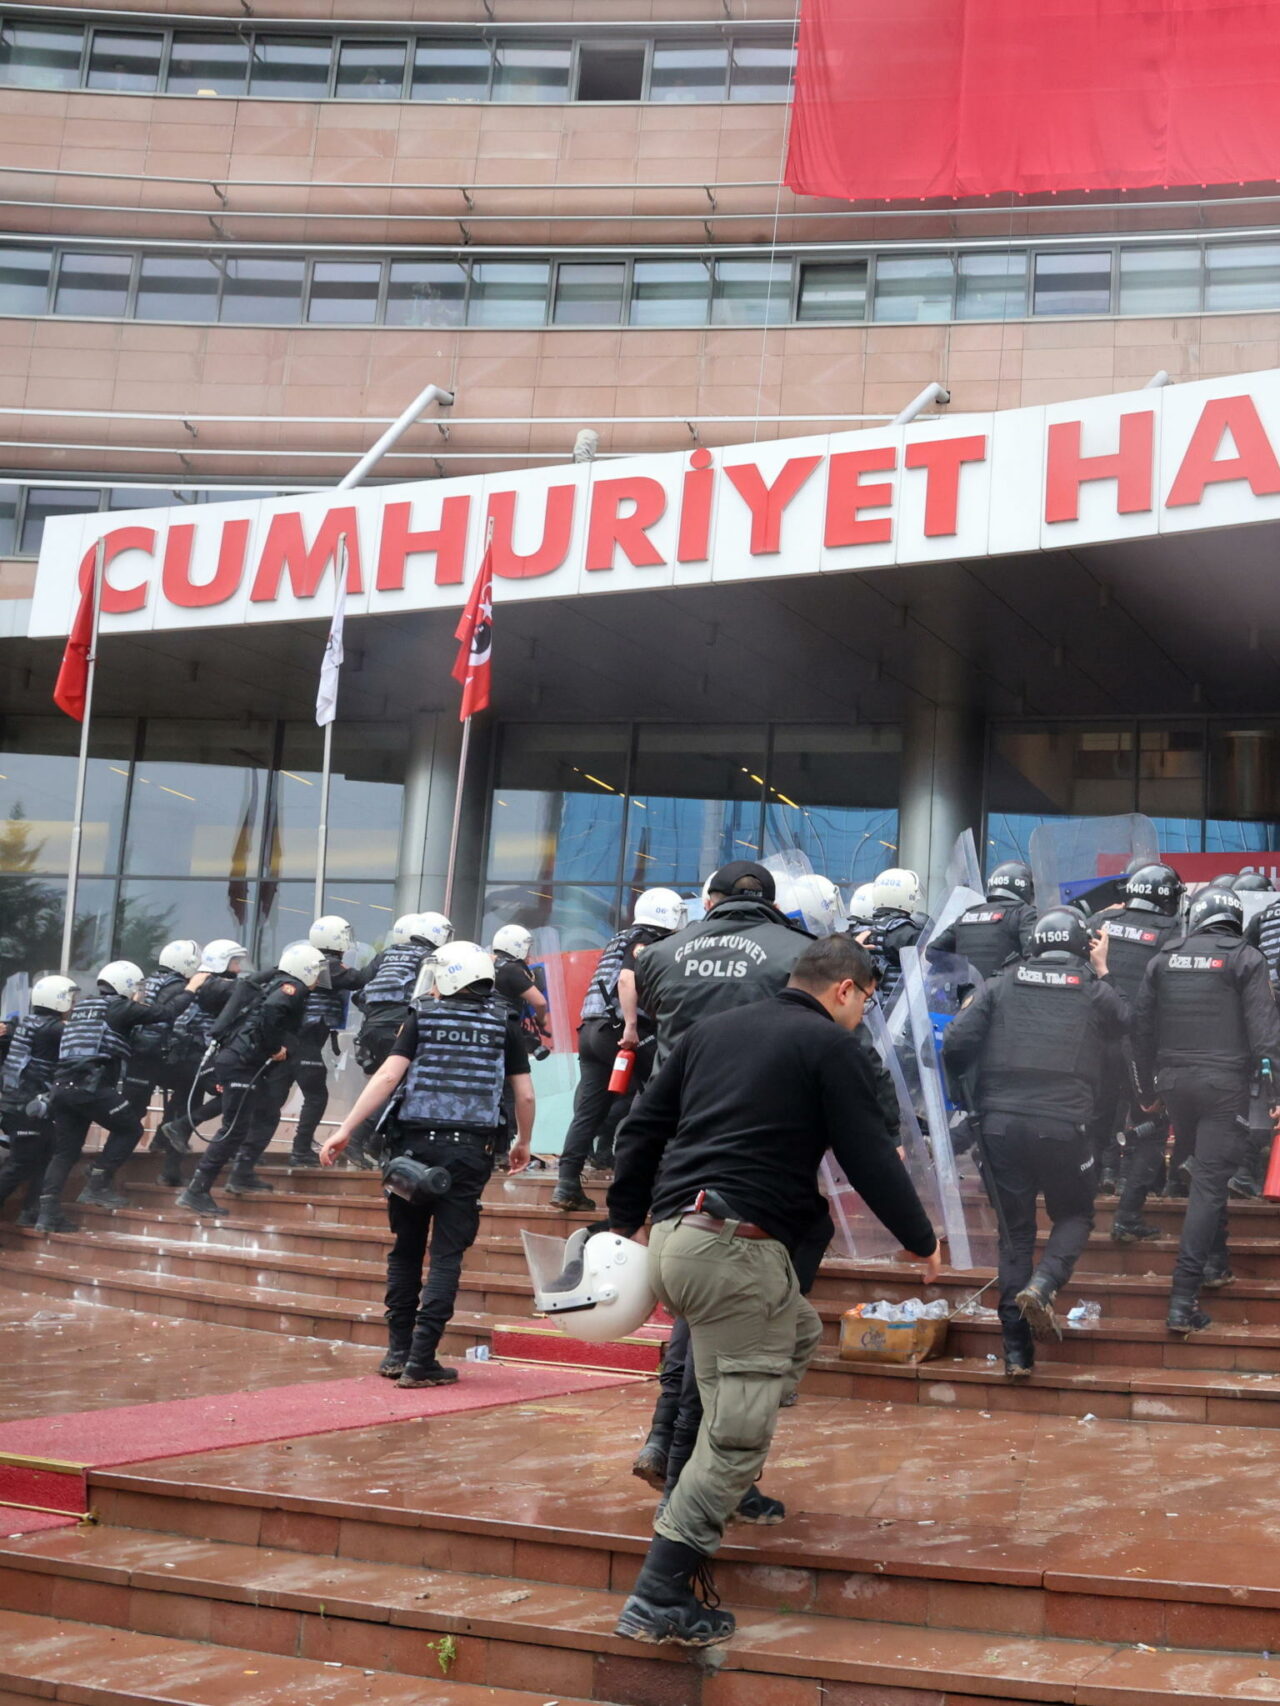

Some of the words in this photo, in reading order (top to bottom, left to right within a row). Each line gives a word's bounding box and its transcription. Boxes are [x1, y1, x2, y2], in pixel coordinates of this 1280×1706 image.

[78, 435, 985, 614] CUMHURİYET
[1157, 886, 1170, 896] 06
[1034, 930, 1070, 944] T1505
[718, 935, 768, 966] KUVVET
[447, 963, 463, 975] 06
[684, 959, 749, 978] POLİS
[435, 1030, 491, 1045] POLİS
